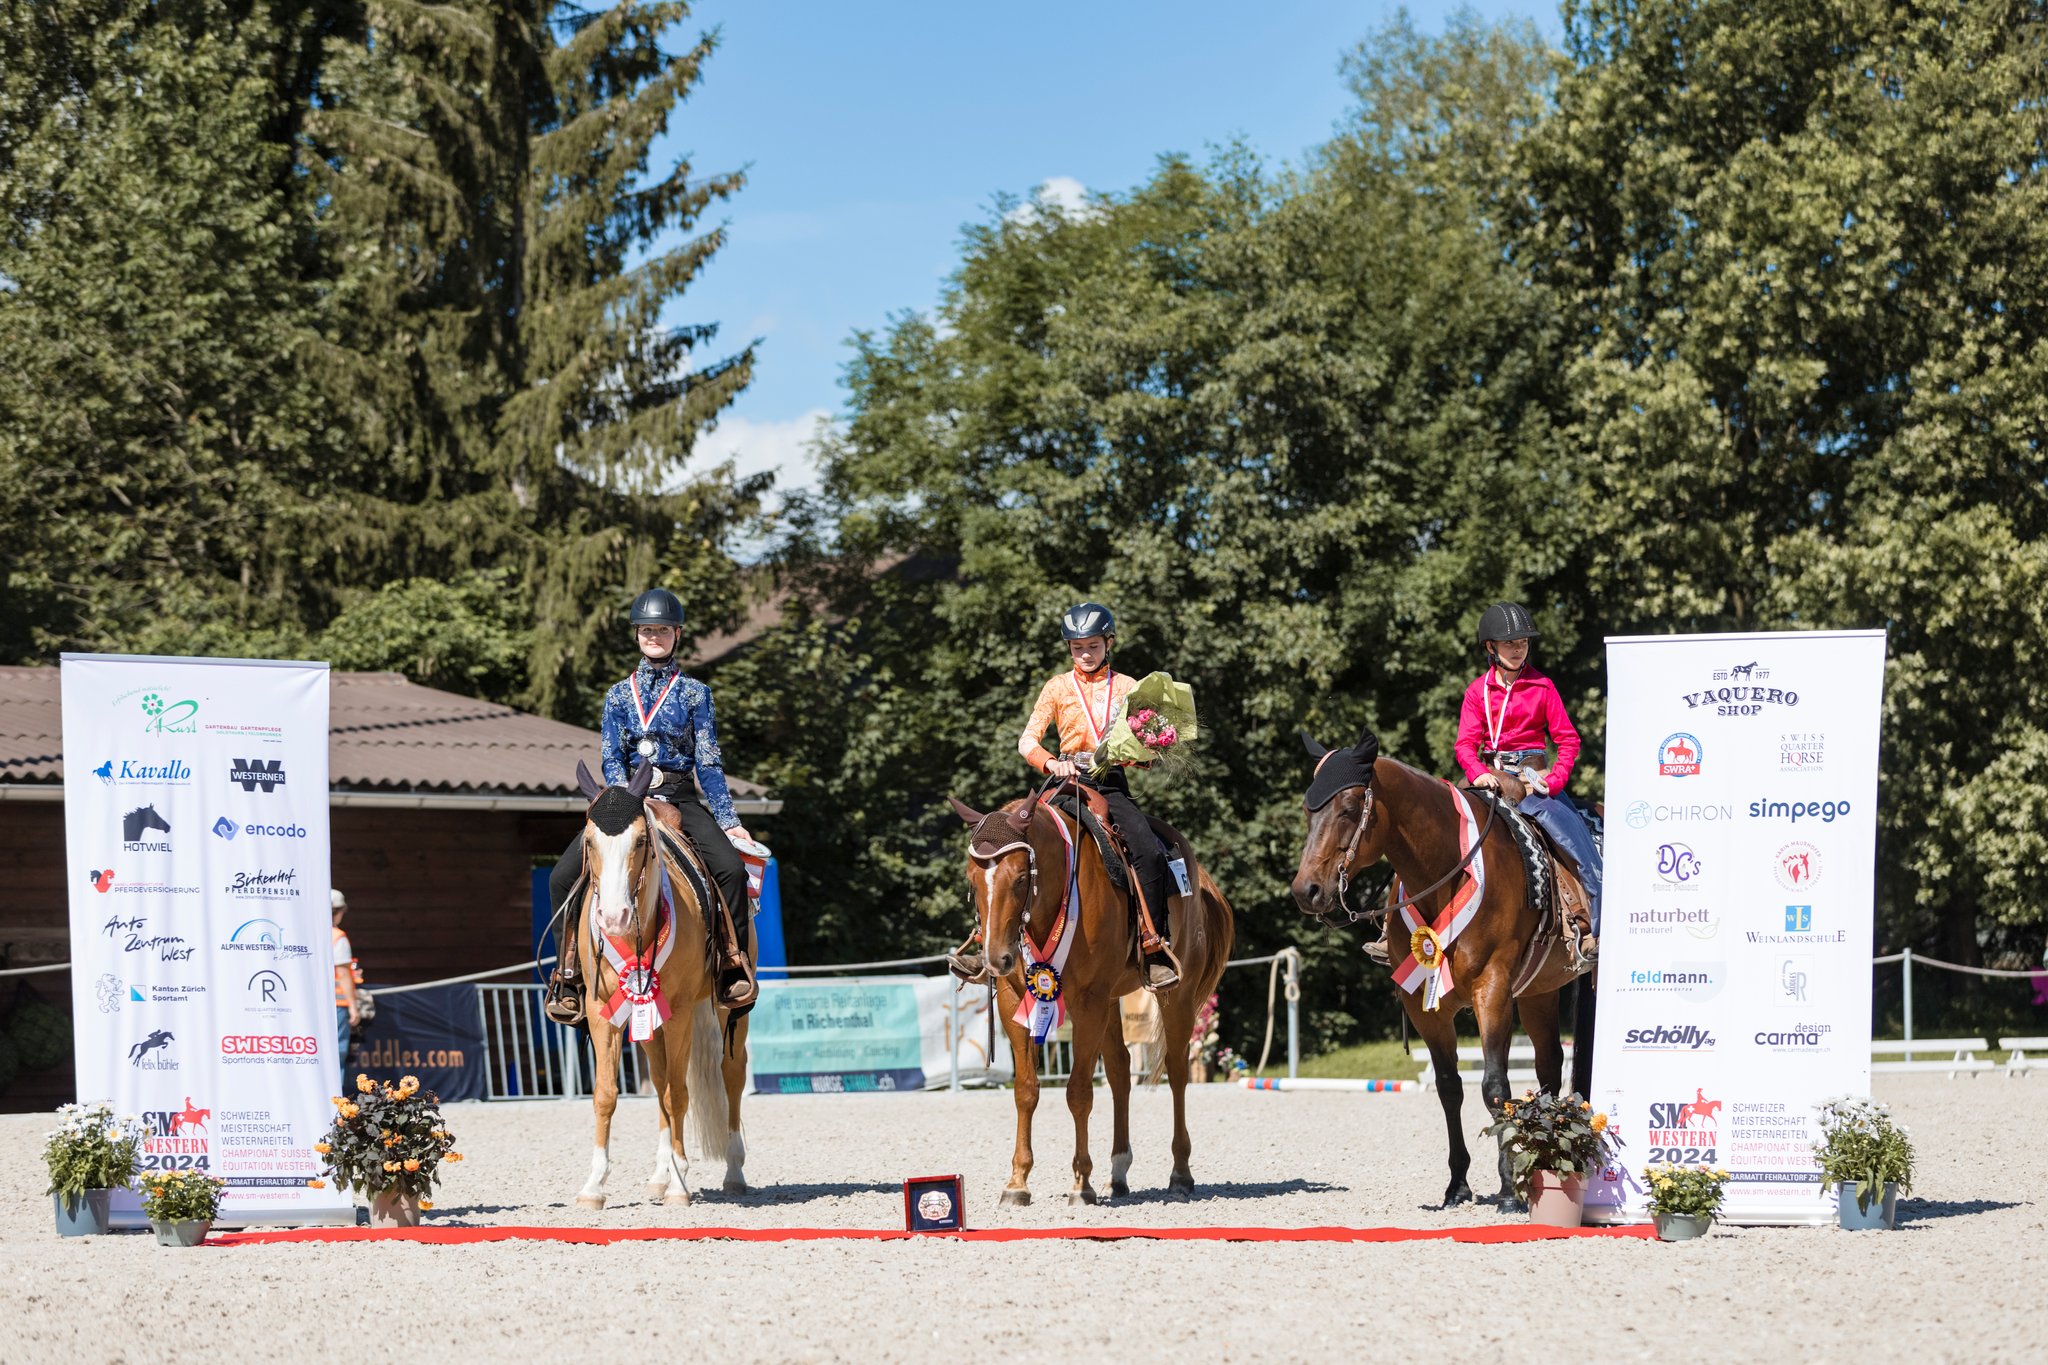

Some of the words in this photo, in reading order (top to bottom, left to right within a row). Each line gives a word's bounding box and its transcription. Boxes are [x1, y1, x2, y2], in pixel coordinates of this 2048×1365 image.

[1712, 672, 1728, 681] ESTD
[1755, 670, 1770, 679] 1977
[1682, 686, 1799, 709] VAQUERO
[1717, 704, 1763, 717] SHOP
[1780, 733, 1825, 742] SWISS
[1780, 742, 1825, 752] QUARTER
[119, 759, 191, 780] Kavallo
[232, 770, 285, 782] WESTERNER
[1654, 805, 1732, 821] CHIRON
[1749, 798, 1851, 823] simpego
[245, 823, 307, 838] encodo
[123, 842, 173, 852] HOTWIEL
[114, 886, 200, 894] PFERDEVERSICHERUNG
[225, 886, 300, 896] PFERDEPENSION
[1629, 908, 1710, 923] naturbett
[102, 915, 148, 938] Auto
[1629, 926, 1638, 934] lit
[1640, 926, 1673, 934] naturel
[124, 933, 184, 952] Zentrum
[221, 943, 244, 951] ALPINE
[245, 943, 276, 951] WESTERN
[283, 945, 308, 953] HORSES
[161, 945, 196, 962] West
[152, 994, 188, 1002] Sportamt
[791, 1014, 804, 1030] in
[806, 1011, 874, 1030] Richenthal
[1795, 1022, 1831, 1037] design
[1624, 1025, 1710, 1049] schölly
[1754, 1032, 1818, 1045] carma
[222, 1035, 318, 1054] SWISSLOS
[222, 1055, 265, 1064] Sportfonds
[267, 1056, 294, 1064] Kanton
[296, 1056, 319, 1064] Zürich
[1732, 1103, 1785, 1113] SCHWEIZER
[220, 1111, 270, 1121] SCHWEIZER
[1648, 1102, 1688, 1129] SM
[1732, 1116, 1807, 1126] MEISTERSCHAFT
[221, 1123, 291, 1133] MEISTERSCHAFT
[1649, 1131, 1717, 1147] WESTERN
[1731, 1129, 1808, 1140] WESTERNREITEN
[144, 1138, 208, 1154] WESTERN
[221, 1136, 294, 1146] WESTERNREITEN
[1730, 1142, 1790, 1152] CHAMPIONAT
[222, 1148, 278, 1158] CHAMPIONAT
[281, 1149, 312, 1158] SUISSE
[1648, 1147, 1718, 1165] 2024
[144, 1155, 210, 1171] 2024
[276, 1161, 316, 1171] WESTERN
[224, 1178, 254, 1186] ARMATT
[256, 1178, 296, 1186] FEHRALTORF
[1730, 1173, 1764, 1181] BARMATT
[1764, 1174, 1808, 1182] FEHRALTORF
[1808, 1174, 1818, 1182] ZH
[1729, 1188, 1811, 1196] www.sm-western.ch
